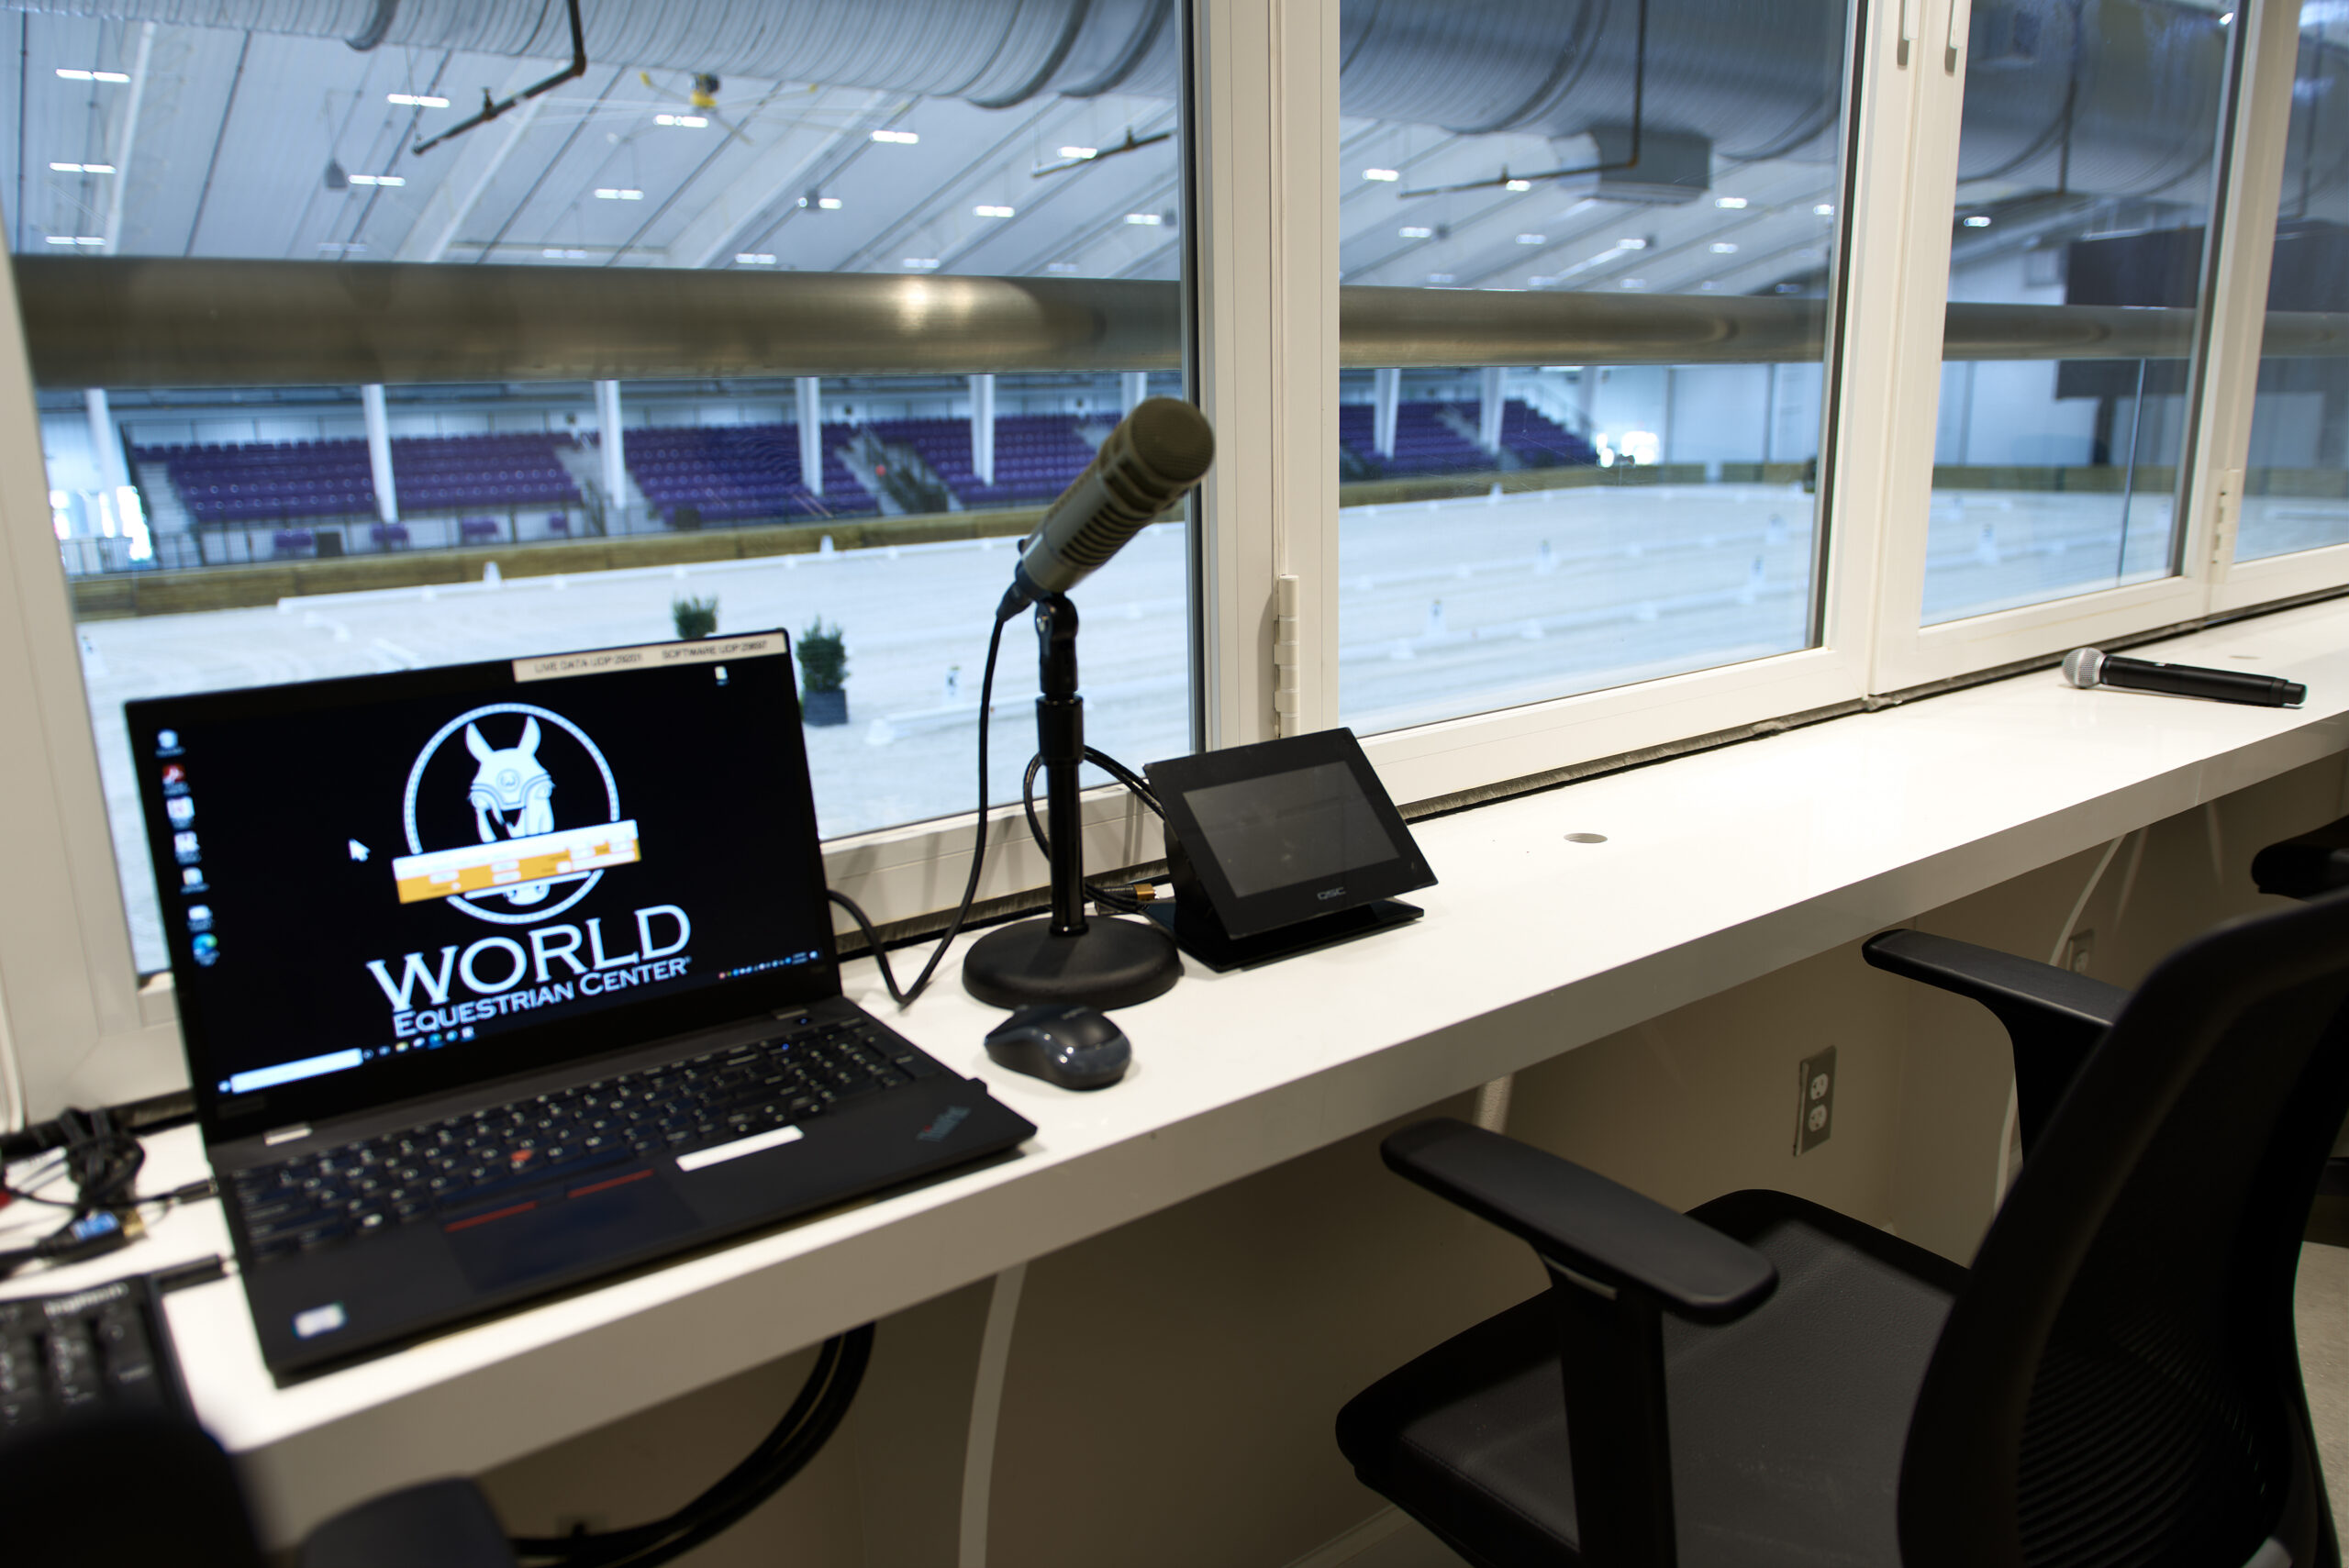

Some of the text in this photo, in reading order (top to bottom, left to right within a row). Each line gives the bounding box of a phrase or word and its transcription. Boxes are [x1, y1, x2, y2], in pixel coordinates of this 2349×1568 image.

[560, 658, 587, 671] DATA
[662, 646, 717, 659] SOFTWARE
[1317, 886, 1346, 900] QSC
[366, 904, 692, 1011] WORLD
[393, 980, 574, 1038] EQUESTRIAN
